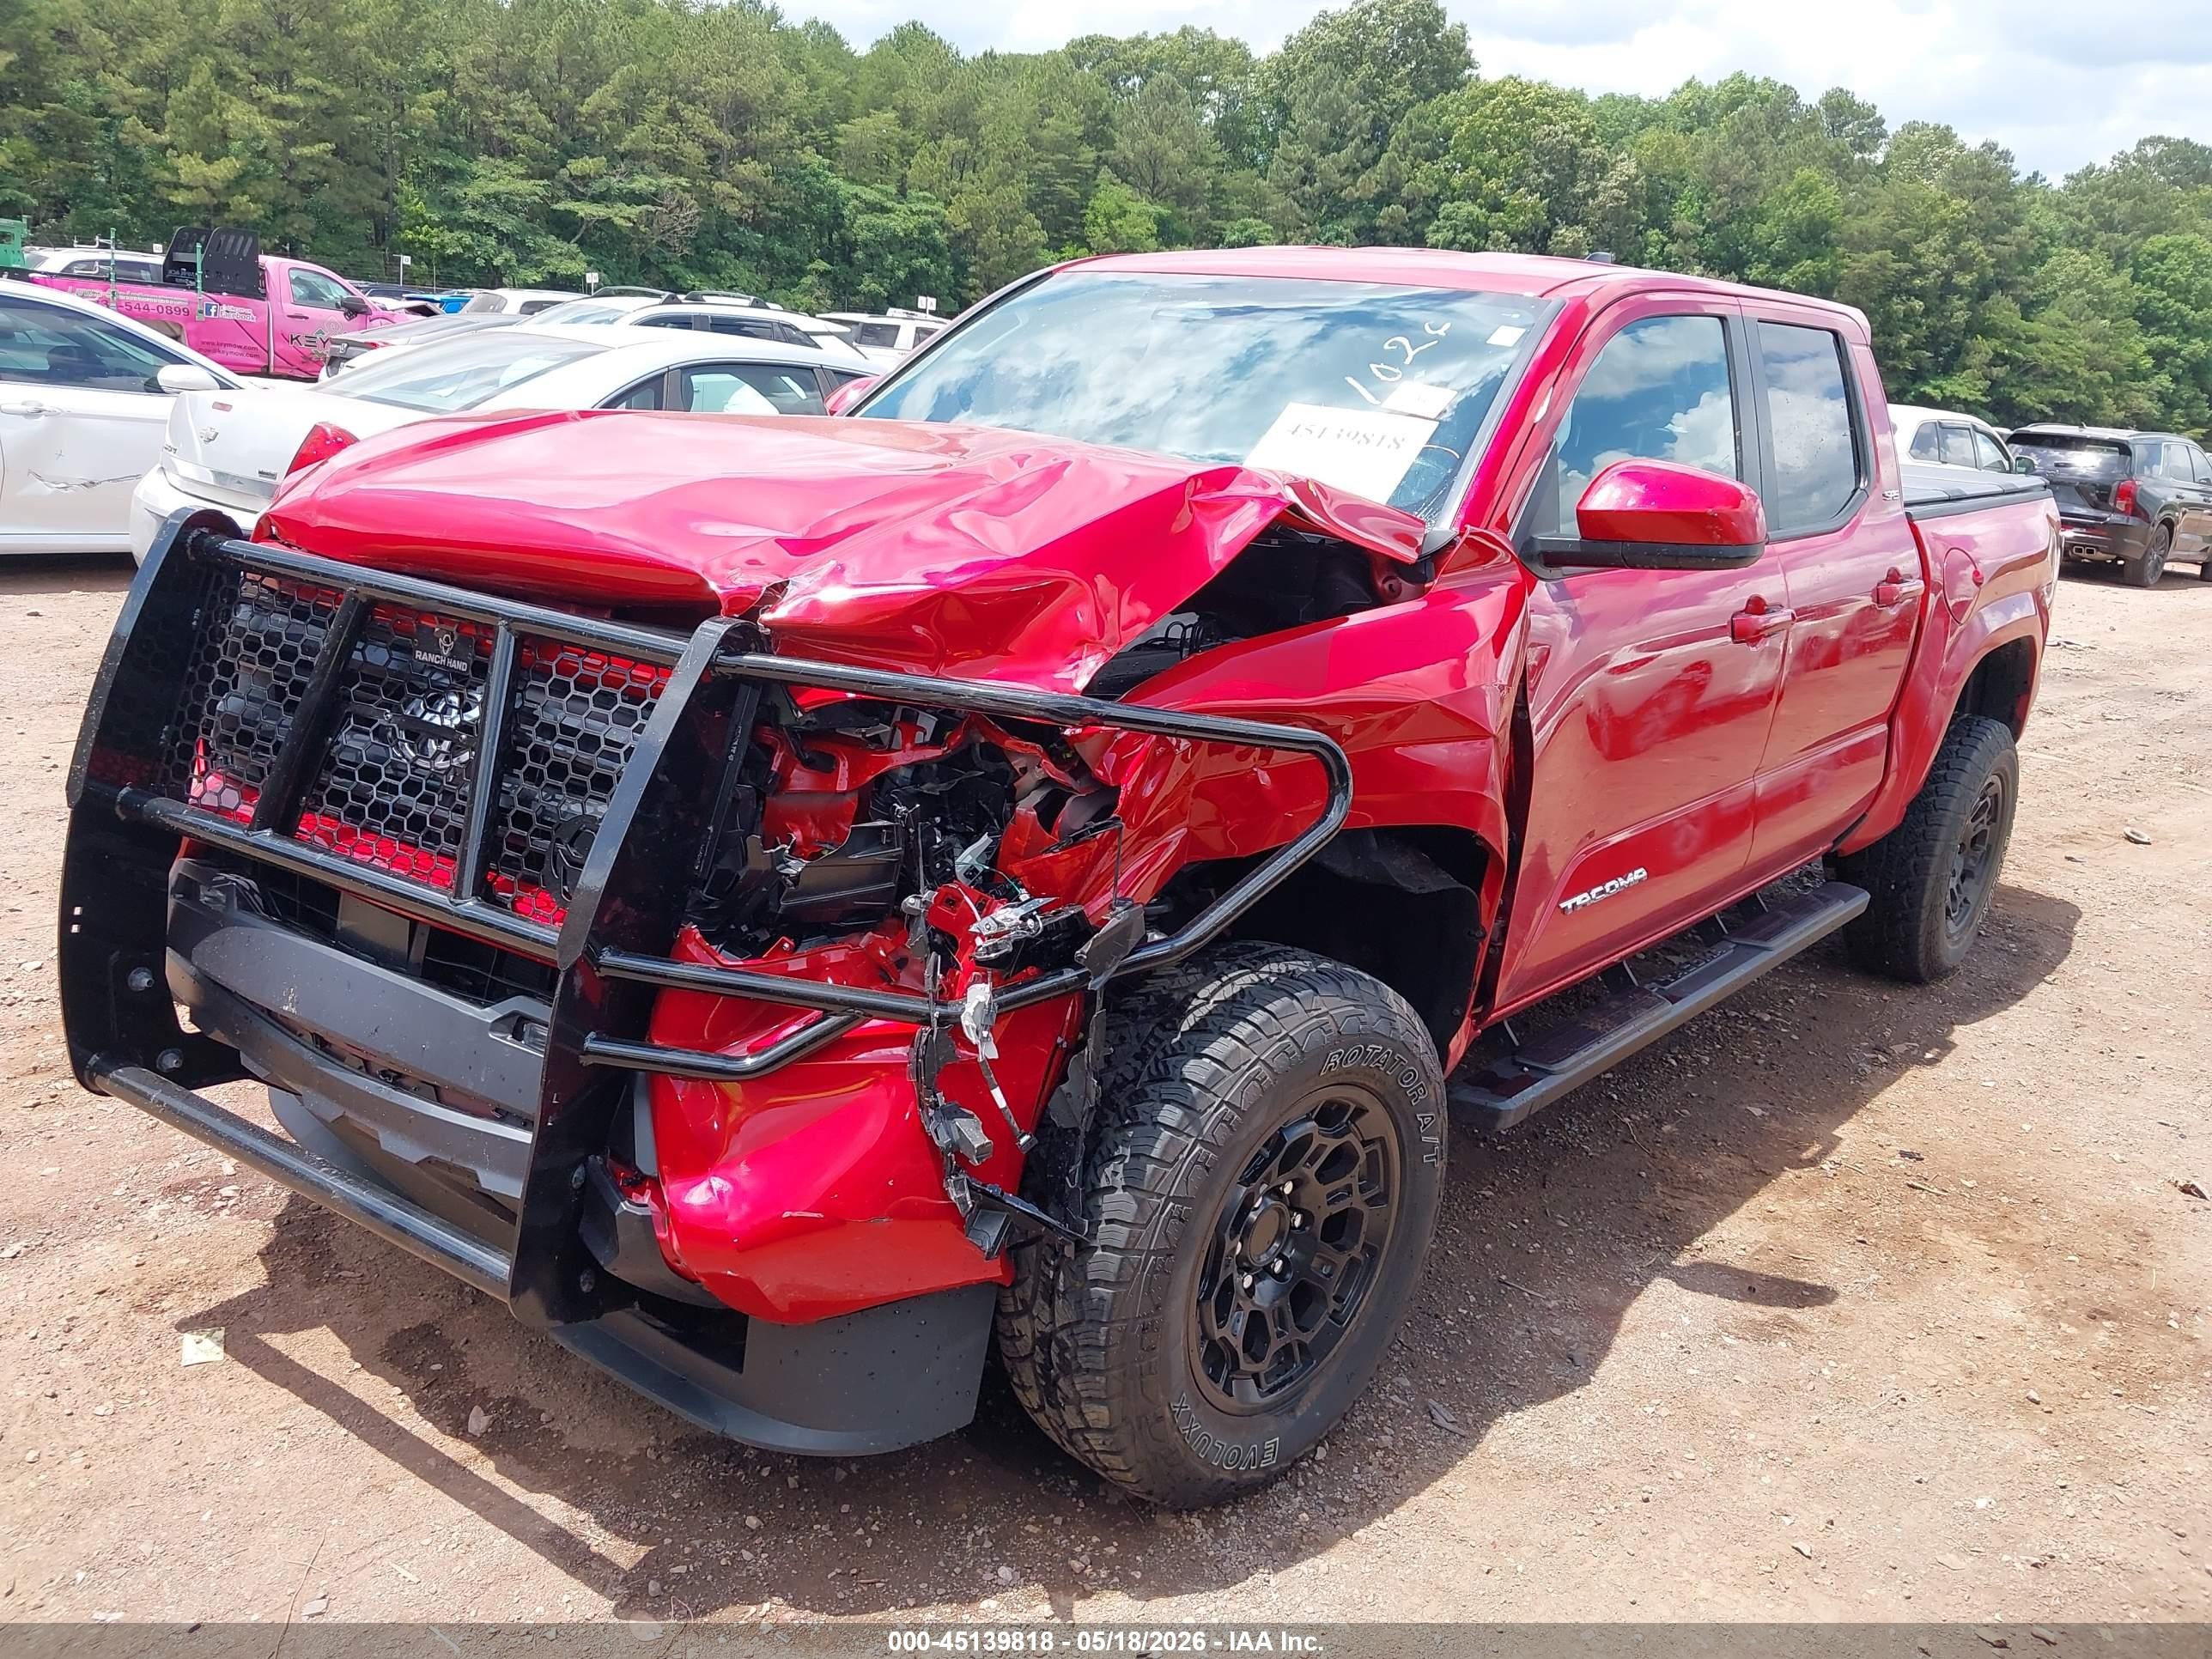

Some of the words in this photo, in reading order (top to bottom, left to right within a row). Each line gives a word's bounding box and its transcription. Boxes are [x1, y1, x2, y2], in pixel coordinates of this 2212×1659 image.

[95, 298, 190, 317] 3-544-0899
[415, 650, 447, 665] RANCH
[446, 658, 468, 672] HAND
[1559, 866, 1648, 915] TACOMA
[1319, 1044, 1429, 1108] ROTATOR
[1417, 1113, 1440, 1168] A/T
[1171, 1392, 1279, 1471] EVOLUXX
